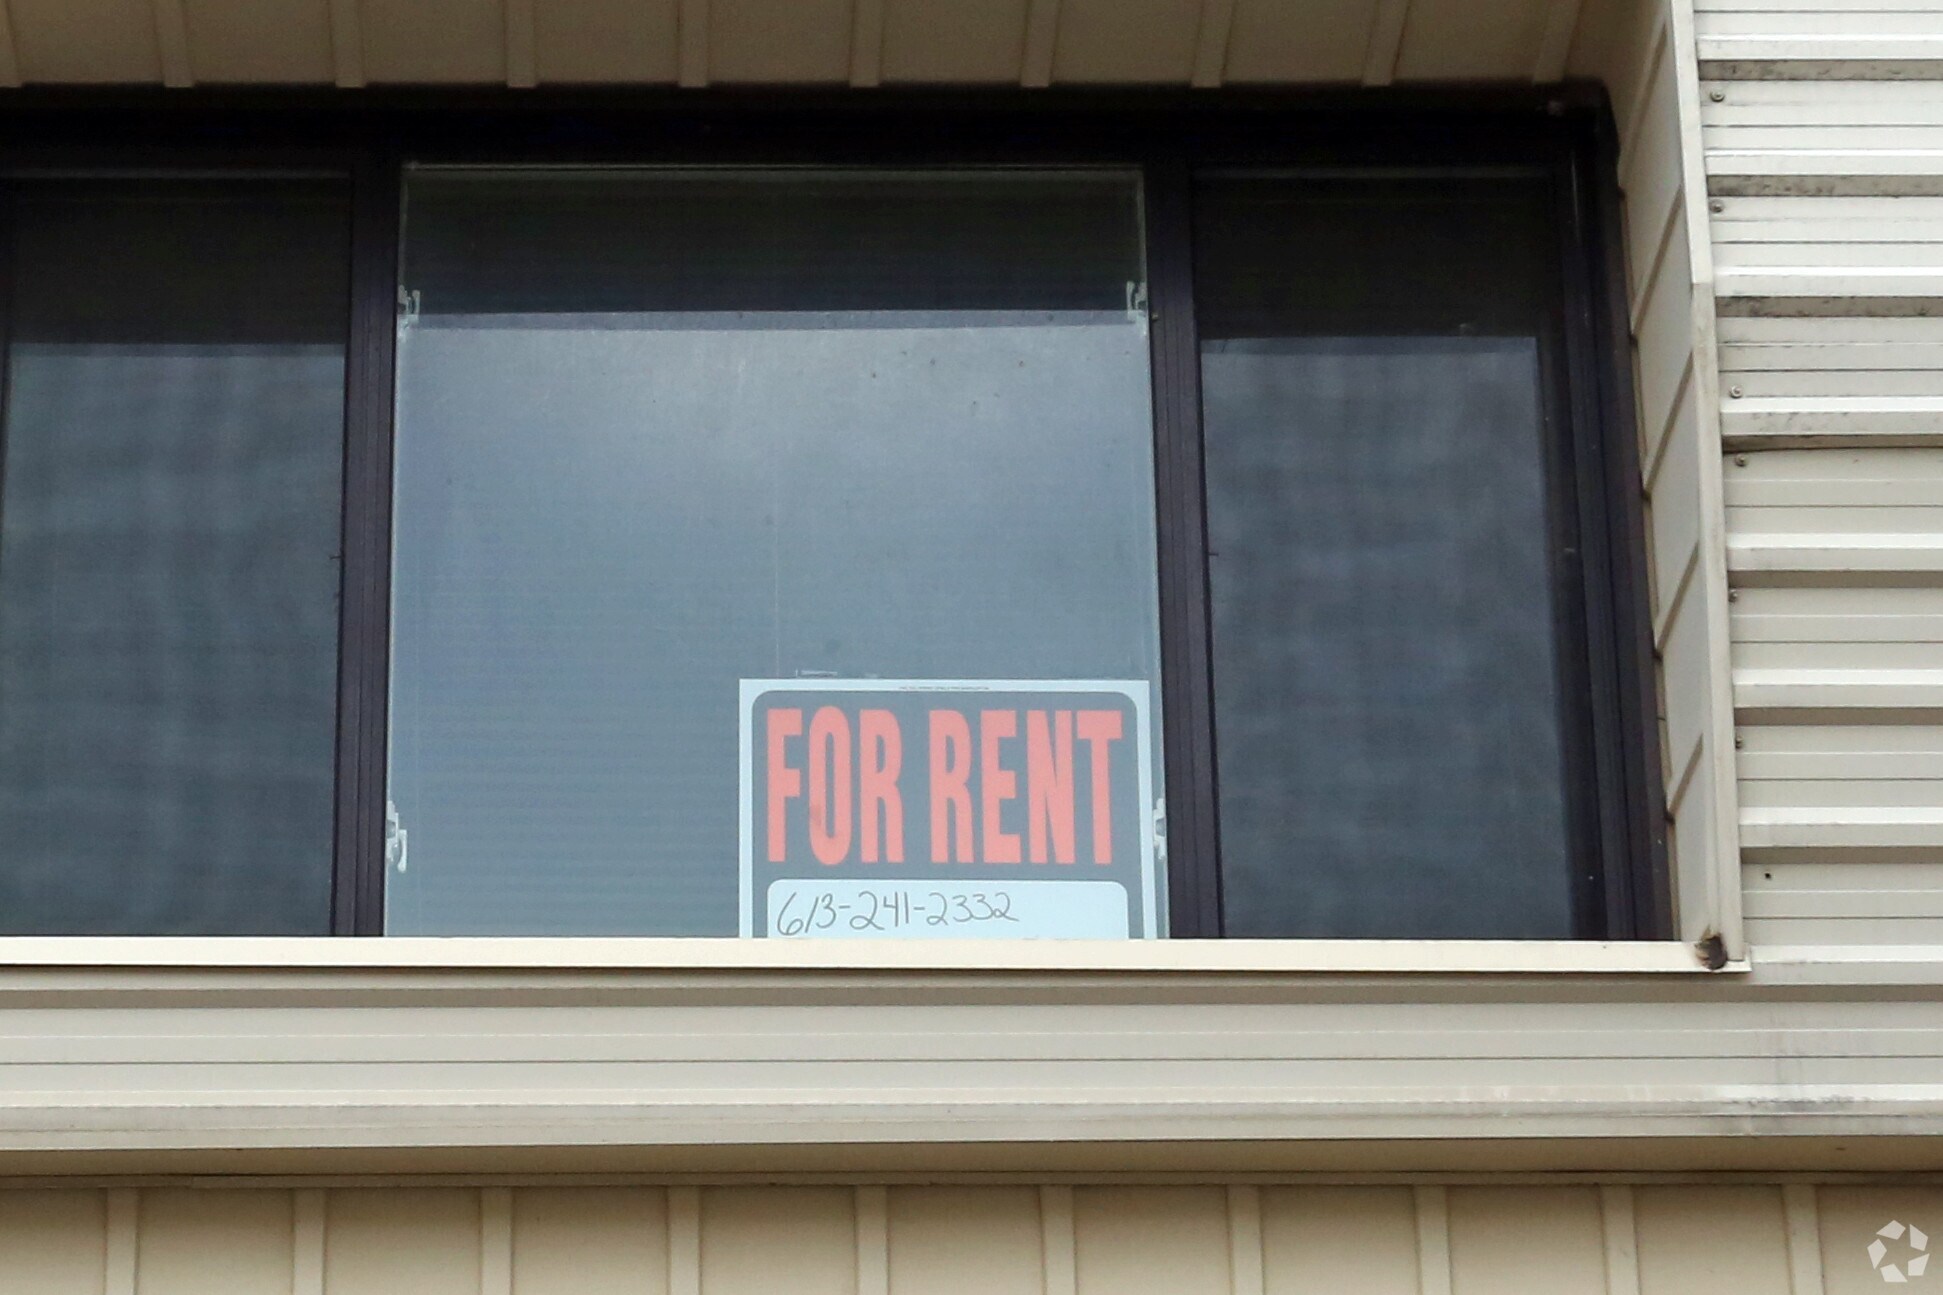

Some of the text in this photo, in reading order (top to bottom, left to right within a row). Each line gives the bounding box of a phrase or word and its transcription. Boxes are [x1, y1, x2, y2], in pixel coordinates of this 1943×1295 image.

[767, 706, 1122, 865] FOR RENT
[777, 891, 1019, 936] 613-241-2332
